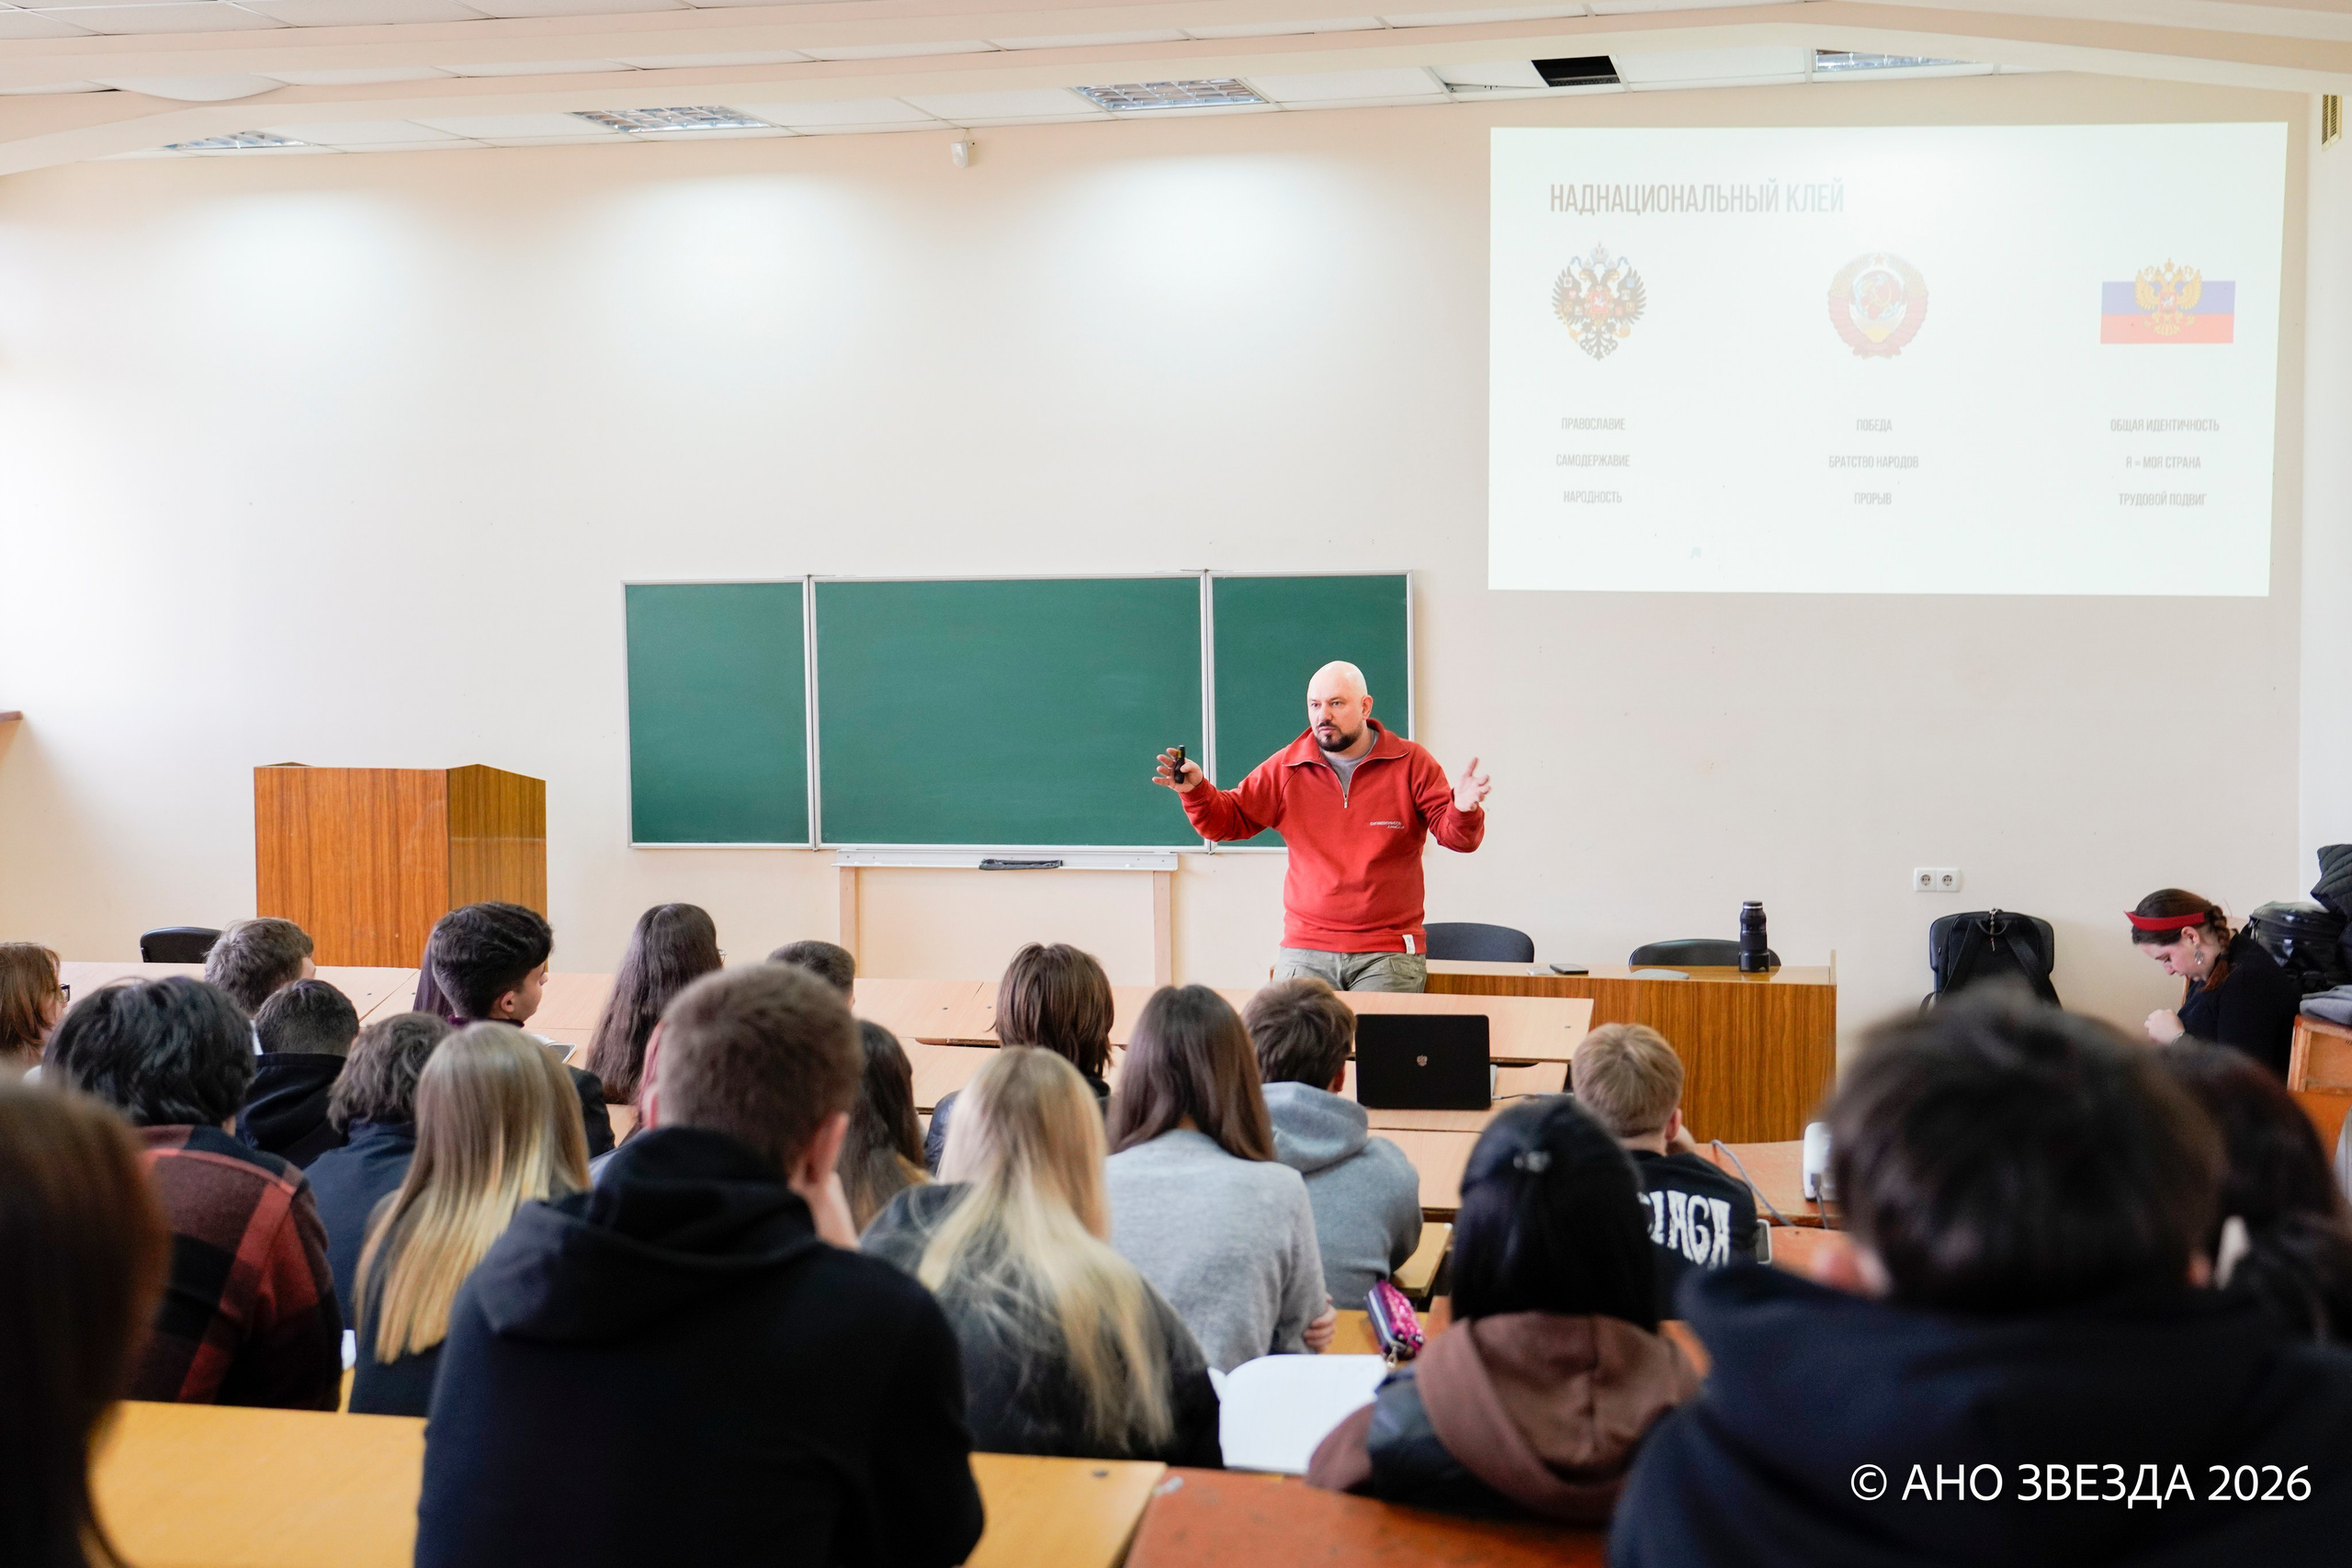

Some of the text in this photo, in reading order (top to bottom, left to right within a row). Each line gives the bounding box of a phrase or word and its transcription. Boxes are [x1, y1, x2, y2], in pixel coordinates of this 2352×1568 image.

[1550, 177, 1844, 216] НАДНАЦИОНАЛЬНЫЙ КЛЕЙ
[1561, 417, 1625, 430] ПРАВОСЛАВИЕ
[1857, 419, 1893, 432] ПОБЕДА
[2110, 419, 2220, 433] ОБЩАЯ ИДЕНТИЧНОСТЬ
[1556, 454, 1630, 468] САМОДЕРЖАВИЕ
[1829, 456, 1919, 469] БРАТСТВО НАРОДОВ
[2126, 456, 2132, 468] Я
[2143, 456, 2163, 468] МОЯ
[2165, 456, 2201, 468] СТРАНА
[1564, 491, 1622, 503] НАРОДНОСТЬ
[1854, 492, 1892, 505] ПРОРЫВ
[2119, 491, 2207, 506] ТРУДОВОЙ ПОДВИГ
